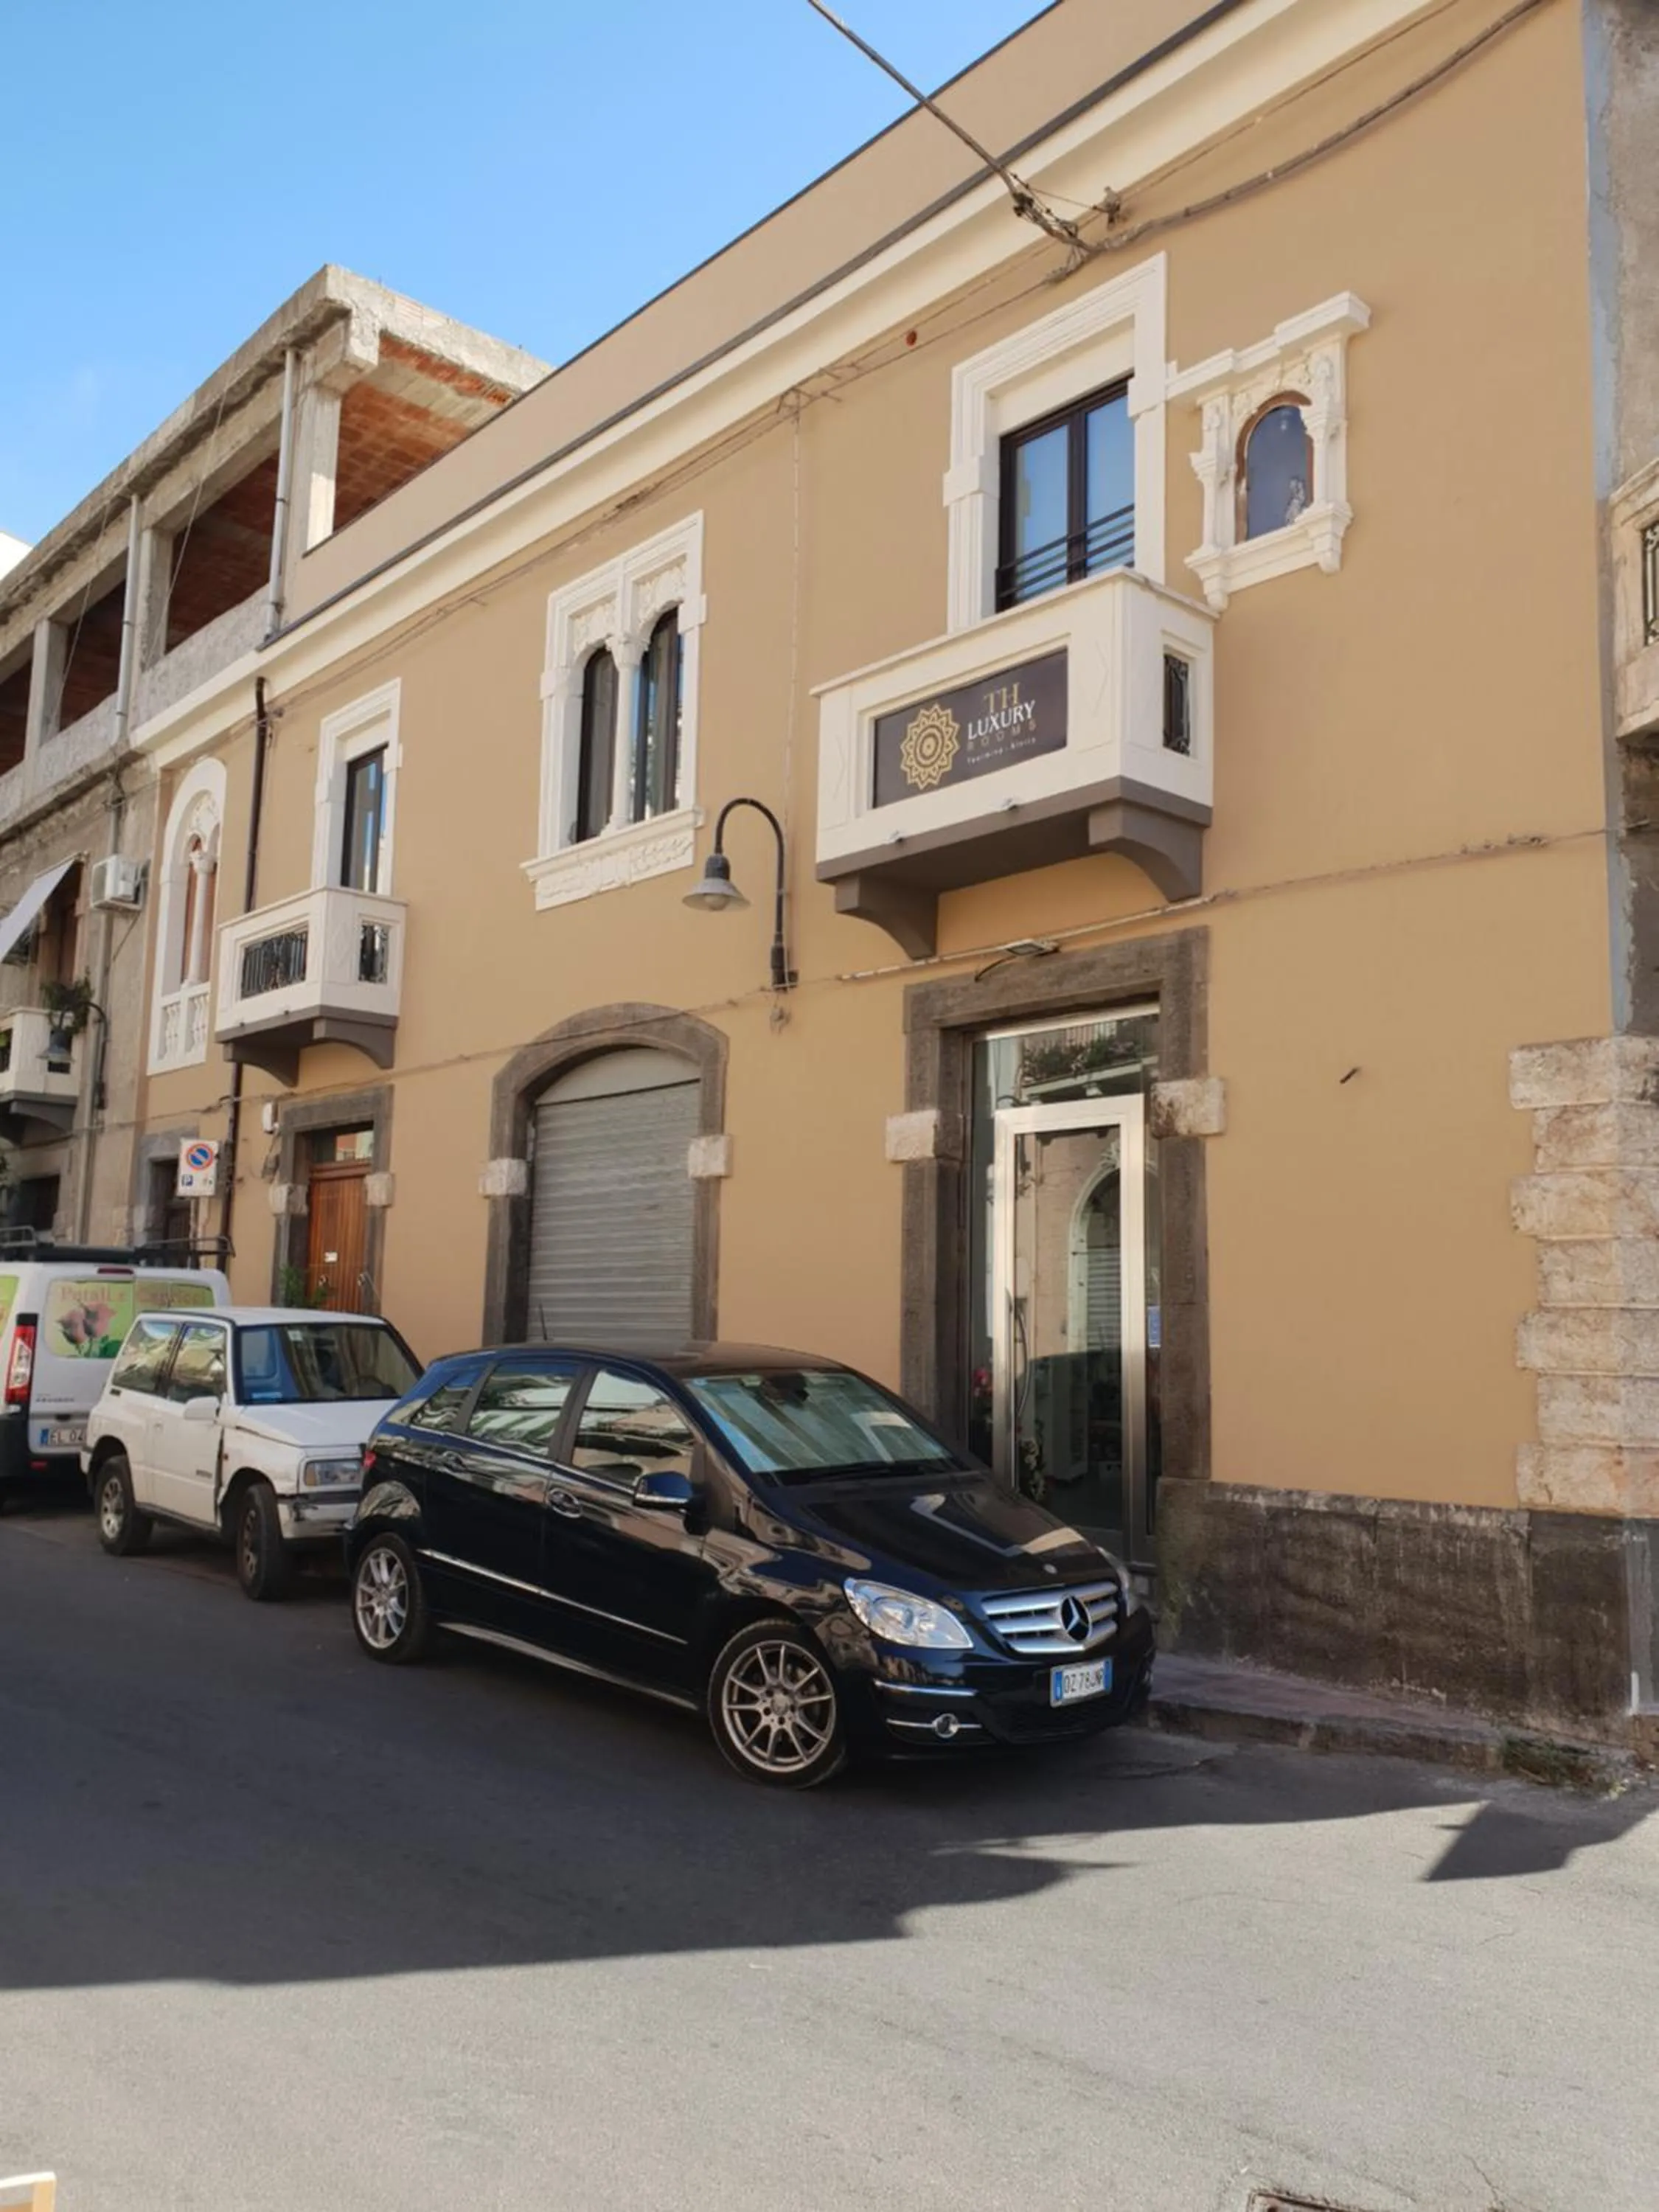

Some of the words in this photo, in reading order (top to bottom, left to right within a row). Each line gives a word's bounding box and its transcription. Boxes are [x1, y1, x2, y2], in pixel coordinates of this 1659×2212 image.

[984, 682, 1020, 713] TH
[967, 699, 1036, 740] LUXURY
[967, 718, 1037, 753] ROOMS
